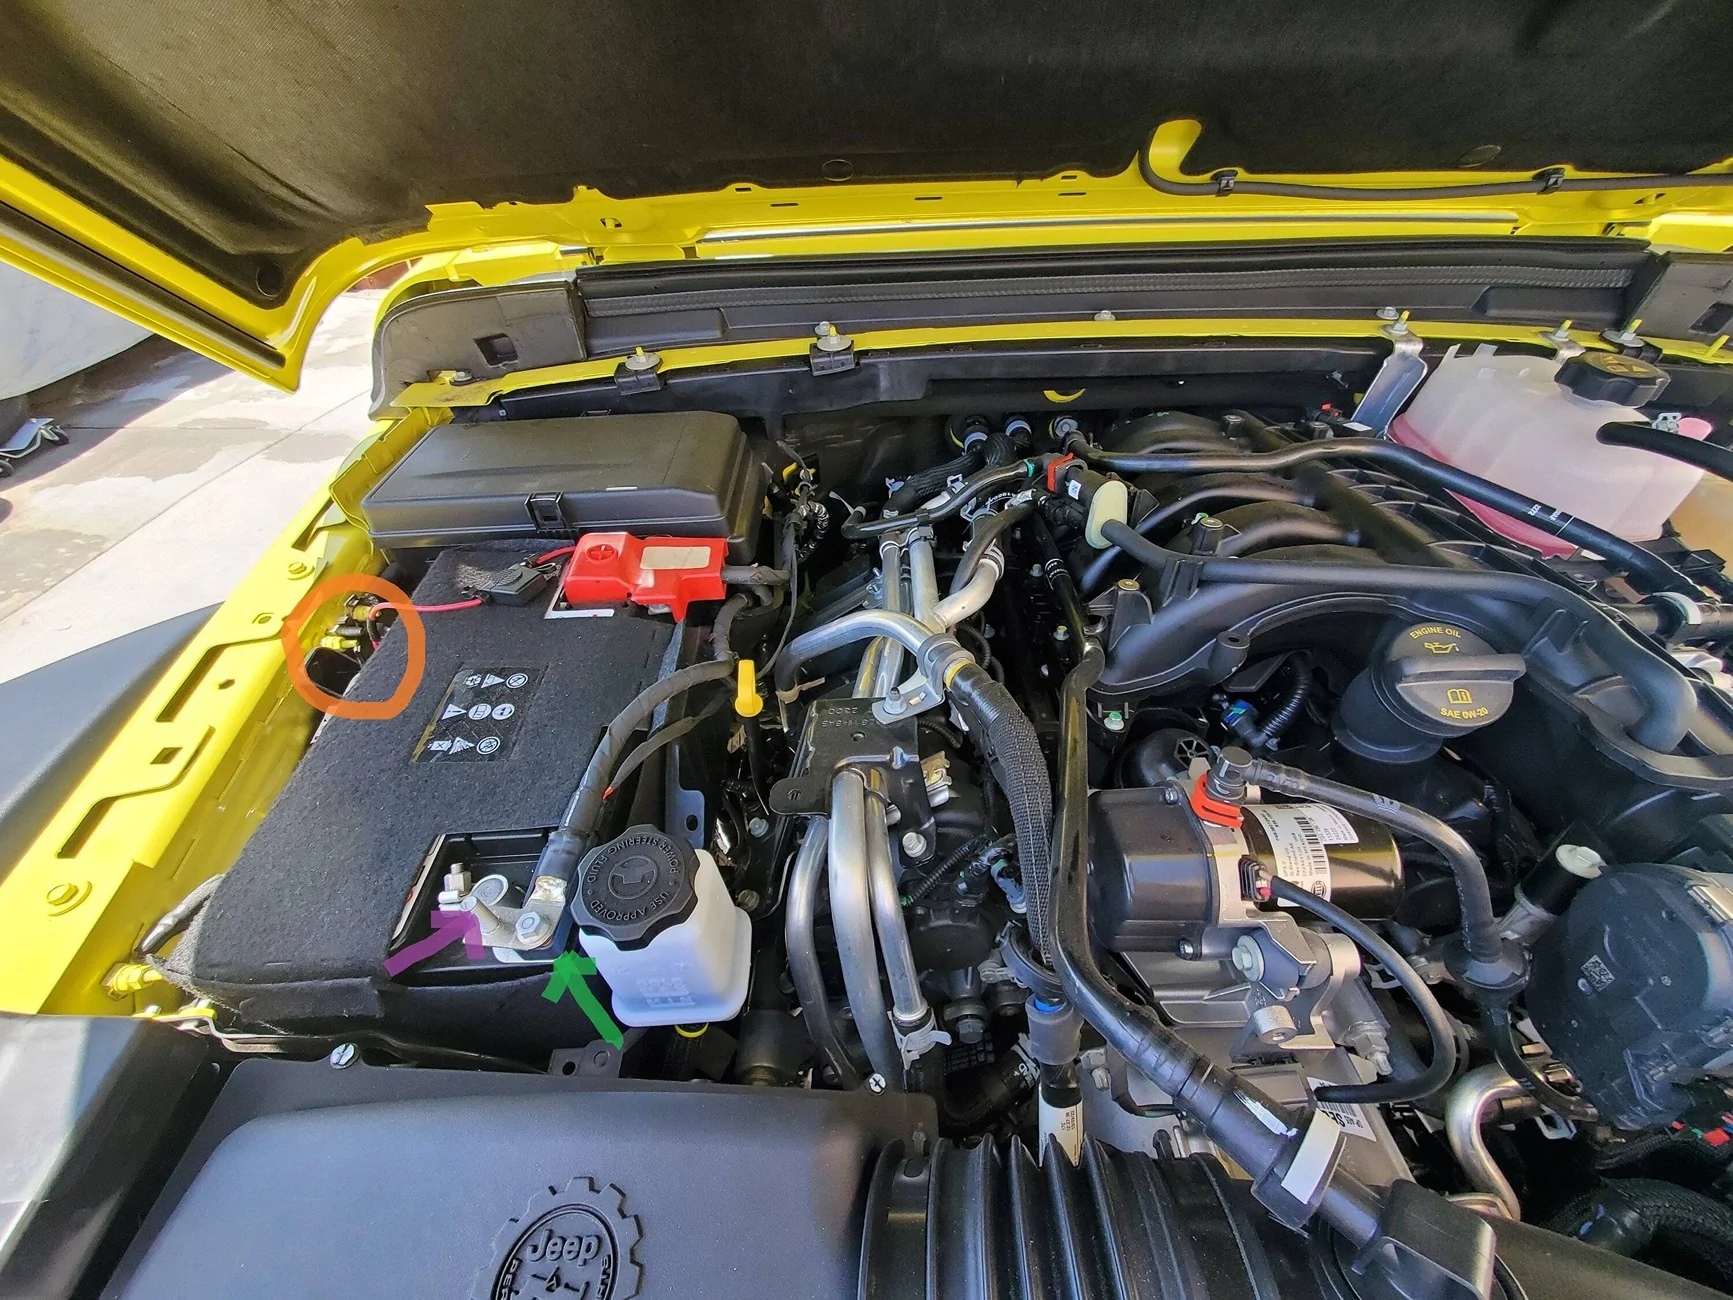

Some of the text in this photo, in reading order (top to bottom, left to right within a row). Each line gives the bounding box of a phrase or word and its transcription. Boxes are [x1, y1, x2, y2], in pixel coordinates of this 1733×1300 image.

[1409, 627, 1461, 639] ENGINE OIL
[1440, 707, 1488, 719] SAE 0W-20
[587, 836, 679, 884] POWER STEERING FLUID
[590, 891, 670, 921] USE APPROVED
[527, 1229, 602, 1267] Jeep
